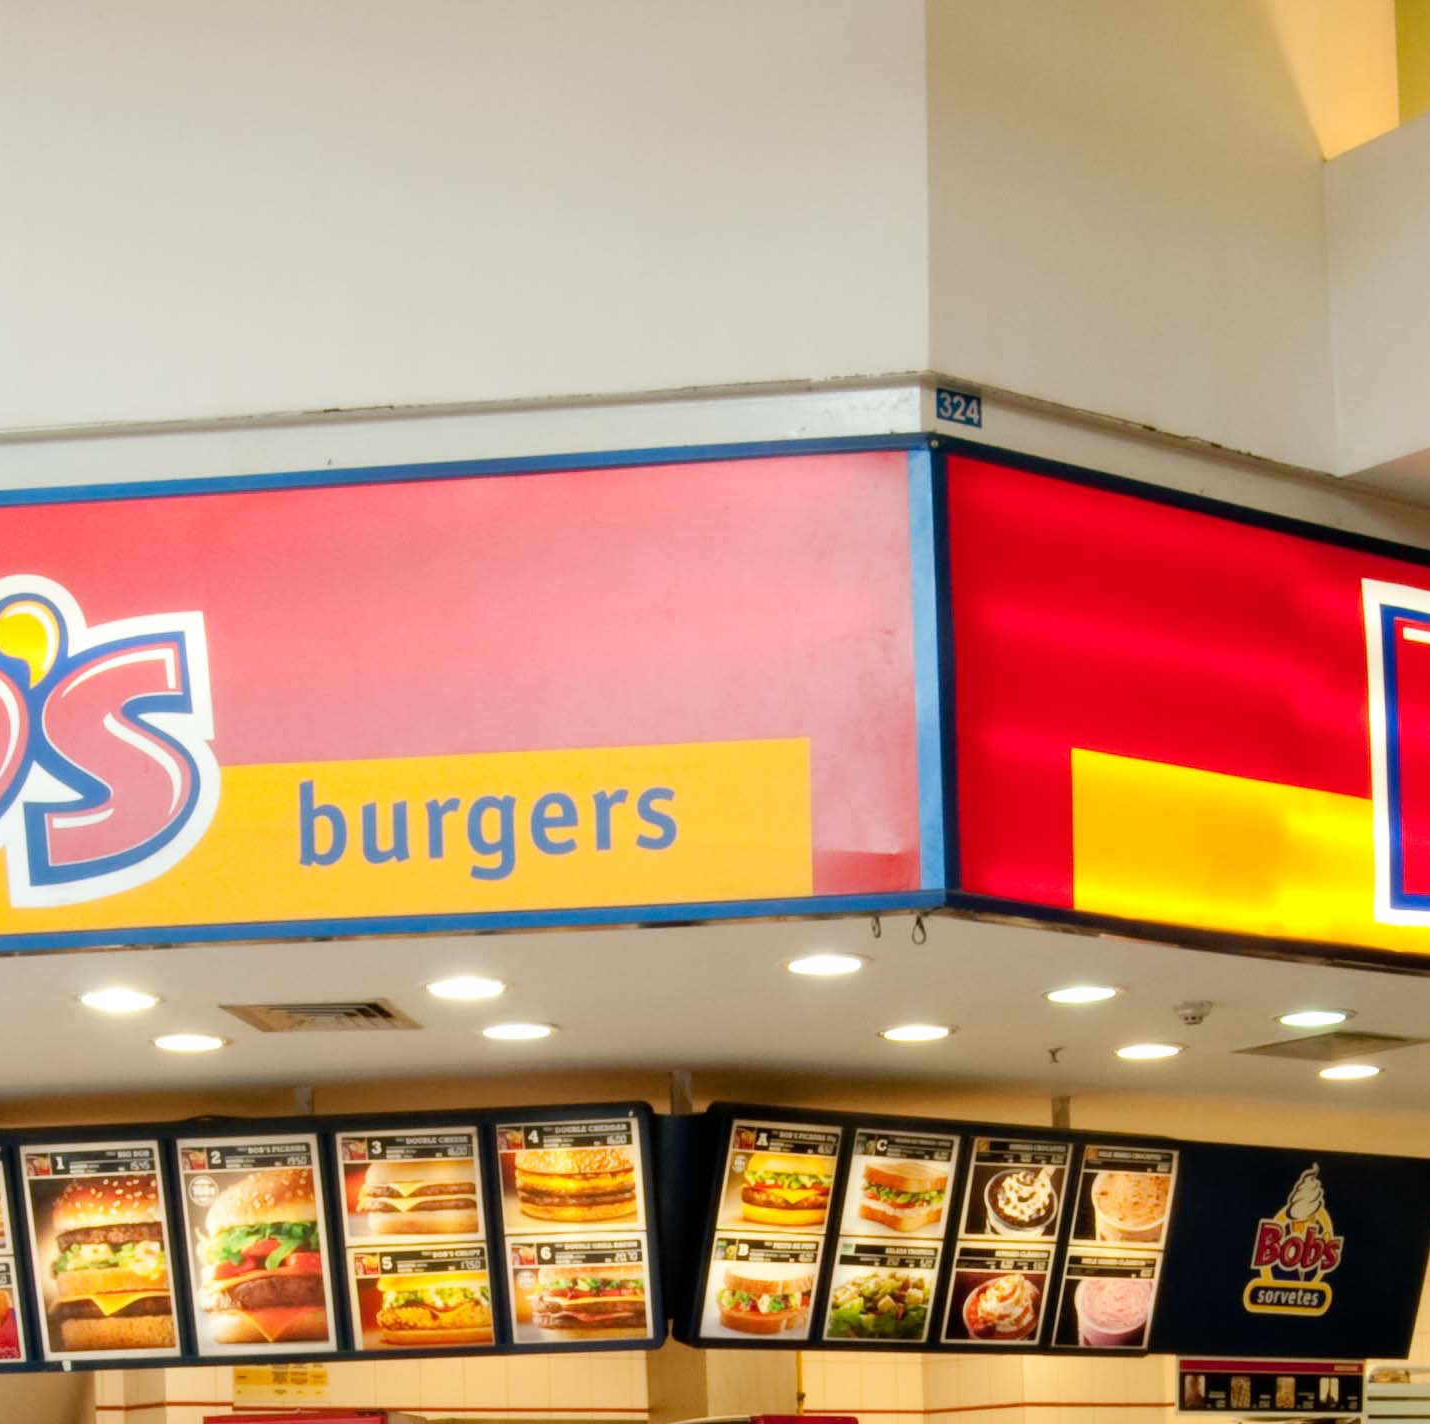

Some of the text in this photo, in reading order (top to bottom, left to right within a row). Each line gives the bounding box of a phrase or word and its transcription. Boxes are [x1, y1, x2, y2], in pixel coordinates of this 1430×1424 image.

[938, 391, 981, 425] 324
[297, 778, 678, 880] burgers
[527, 1129, 540, 1144] 4
[755, 1132, 769, 1146] A
[371, 1140, 383, 1155] 3
[876, 1138, 889, 1152] C
[55, 1155, 65, 1170] 1
[210, 1150, 222, 1165] 2
[540, 1246, 552, 1260] 6
[1252, 1219, 1343, 1274] Bob's
[381, 1255, 393, 1270] 5
[1256, 1288, 1319, 1307] sorvetes
